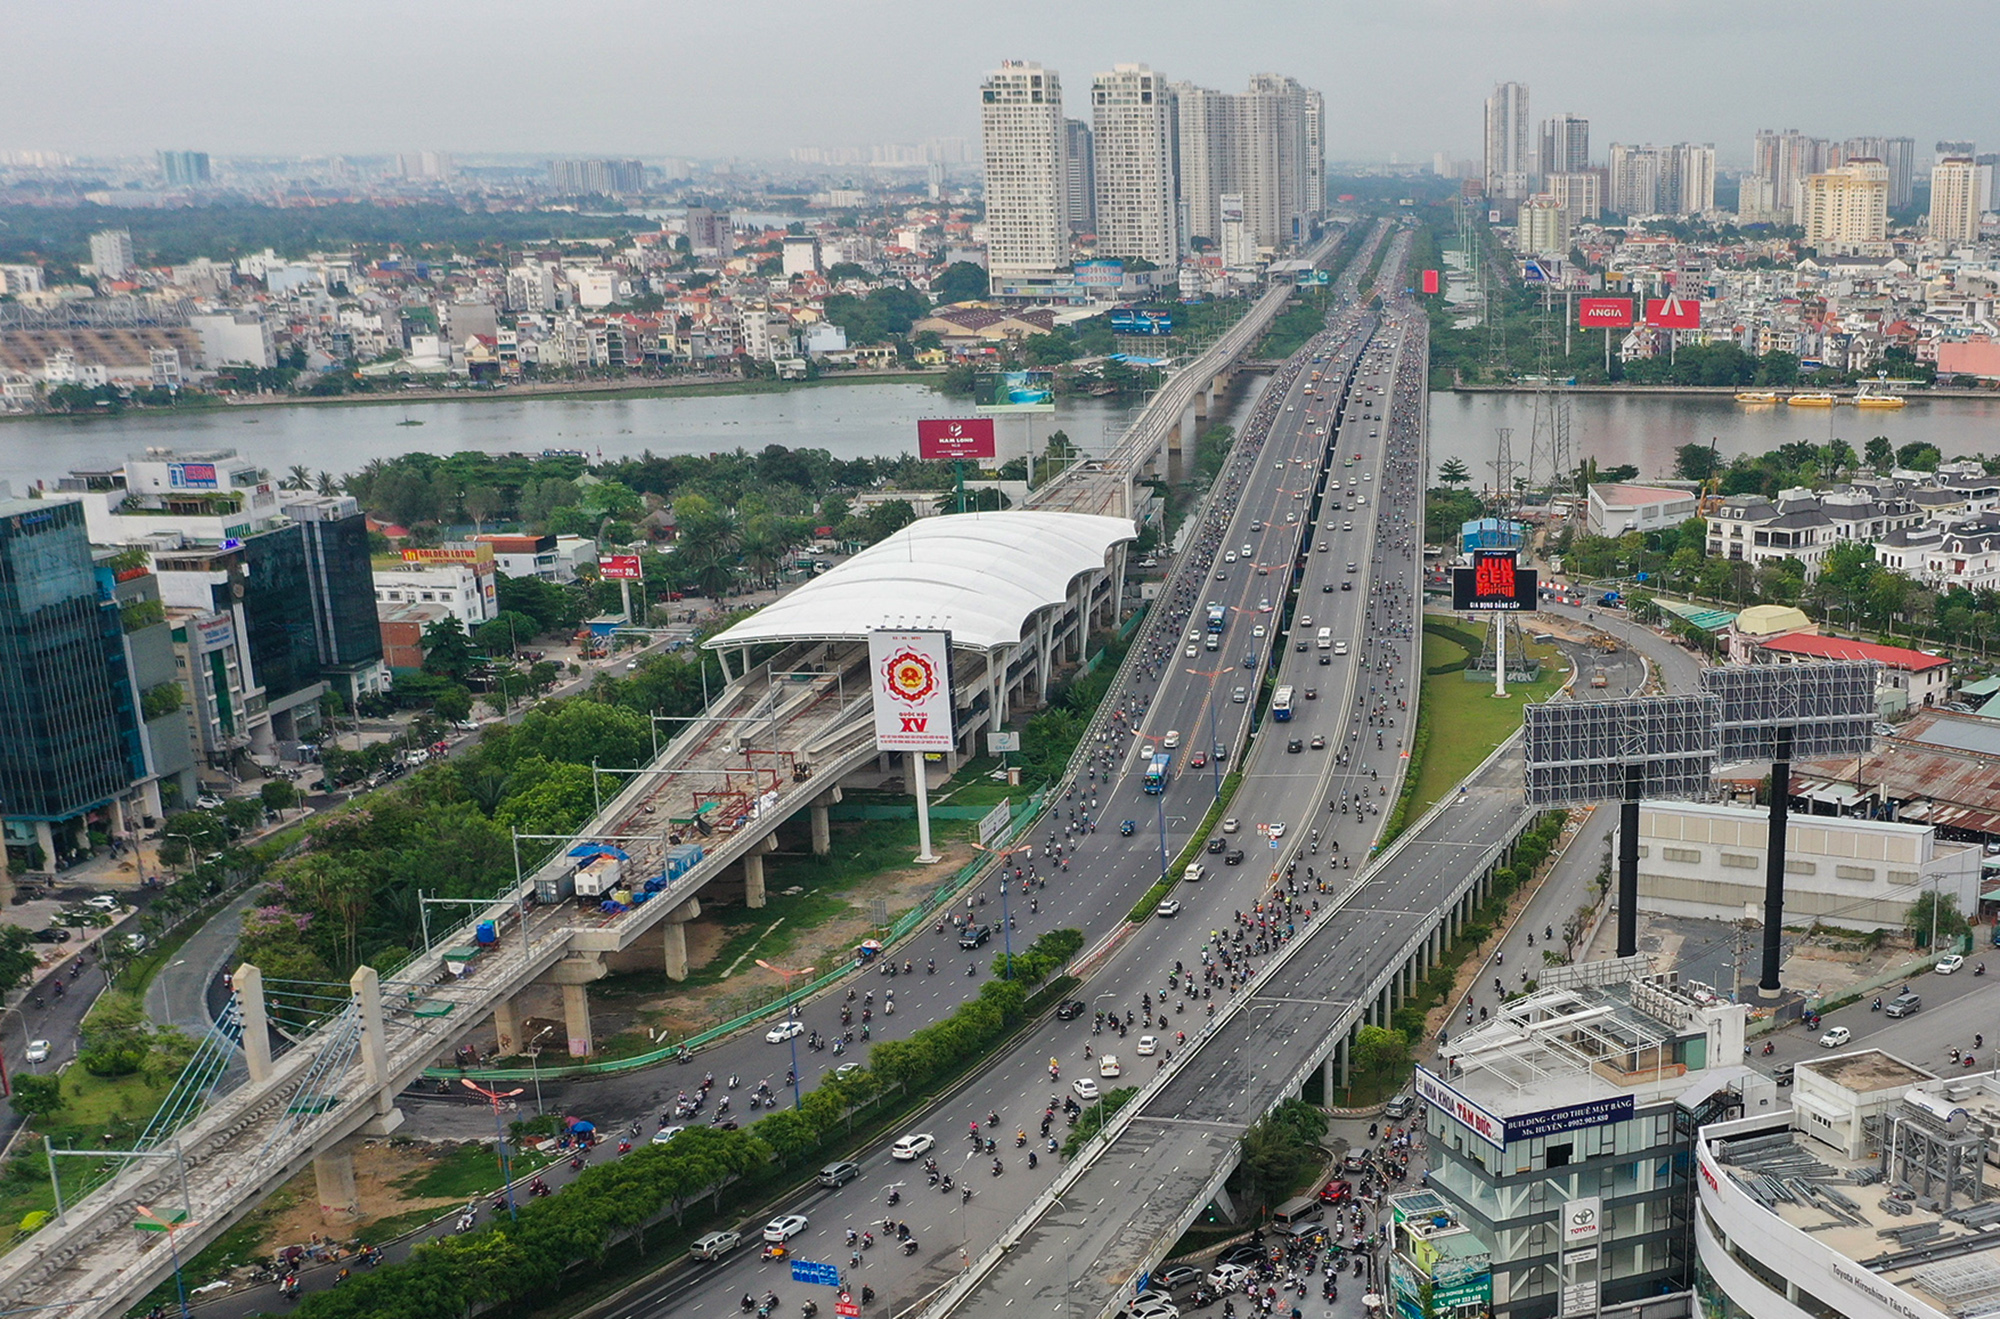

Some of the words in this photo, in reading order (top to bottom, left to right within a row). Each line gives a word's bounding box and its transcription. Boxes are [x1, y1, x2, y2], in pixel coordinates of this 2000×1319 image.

[1588, 309, 1622, 317] ANGIA
[419, 549, 449, 558] GOLDEN
[450, 549, 476, 558] LOTUS
[900, 718, 927, 732] XV
[1438, 1089, 1455, 1114] KHOA
[1456, 1102, 1474, 1127] TÂM
[1508, 1116, 1546, 1130] BUILDING
[1551, 1110, 1568, 1121] CHO
[1569, 1106, 1591, 1118] THUÊ
[1570, 1225, 1596, 1235] TOYOTA
[1832, 1263, 1854, 1284] Toyota
[1854, 1276, 1887, 1305] Hiroshima
